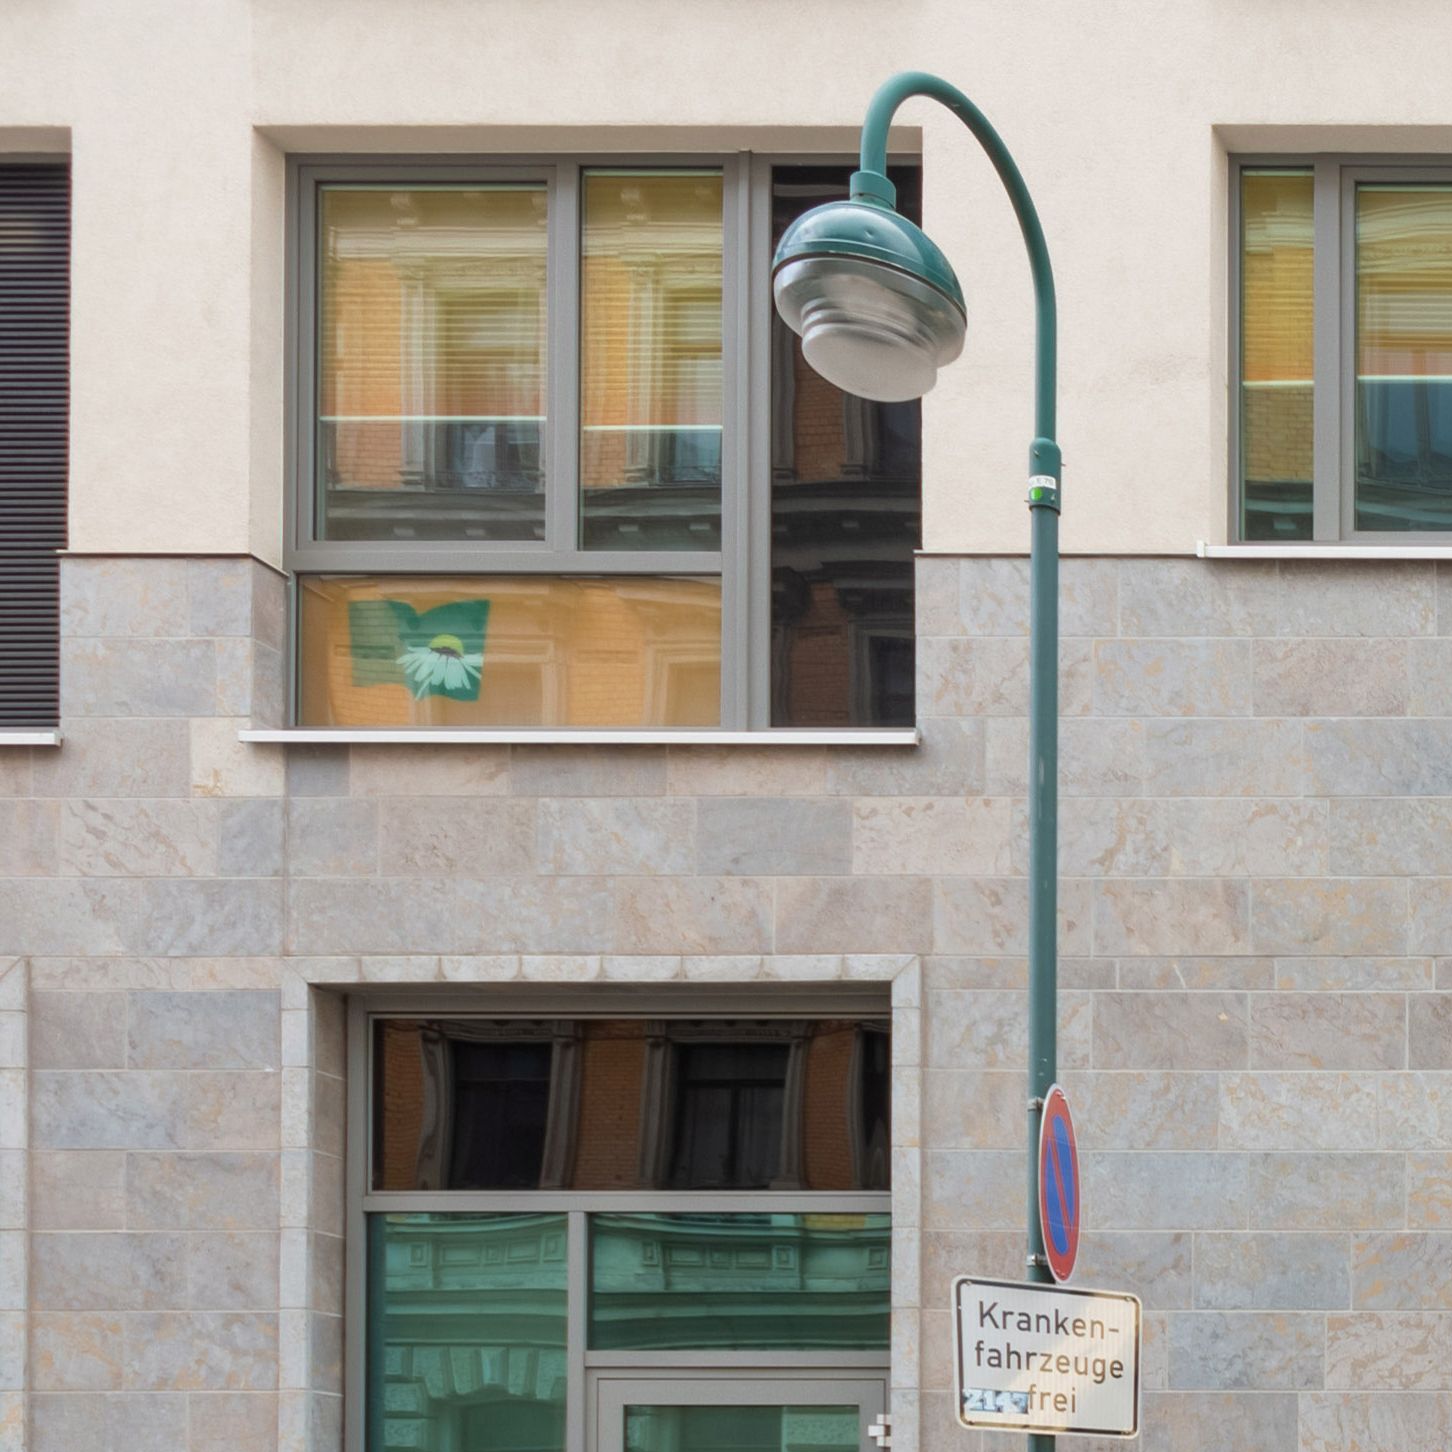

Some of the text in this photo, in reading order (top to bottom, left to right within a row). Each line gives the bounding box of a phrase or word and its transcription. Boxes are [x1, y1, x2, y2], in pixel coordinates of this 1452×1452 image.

[978, 1300, 1120, 1340] Kranken-
[974, 1340, 1124, 1384] fahrzeuge
[1028, 1384, 1077, 1413] frei
